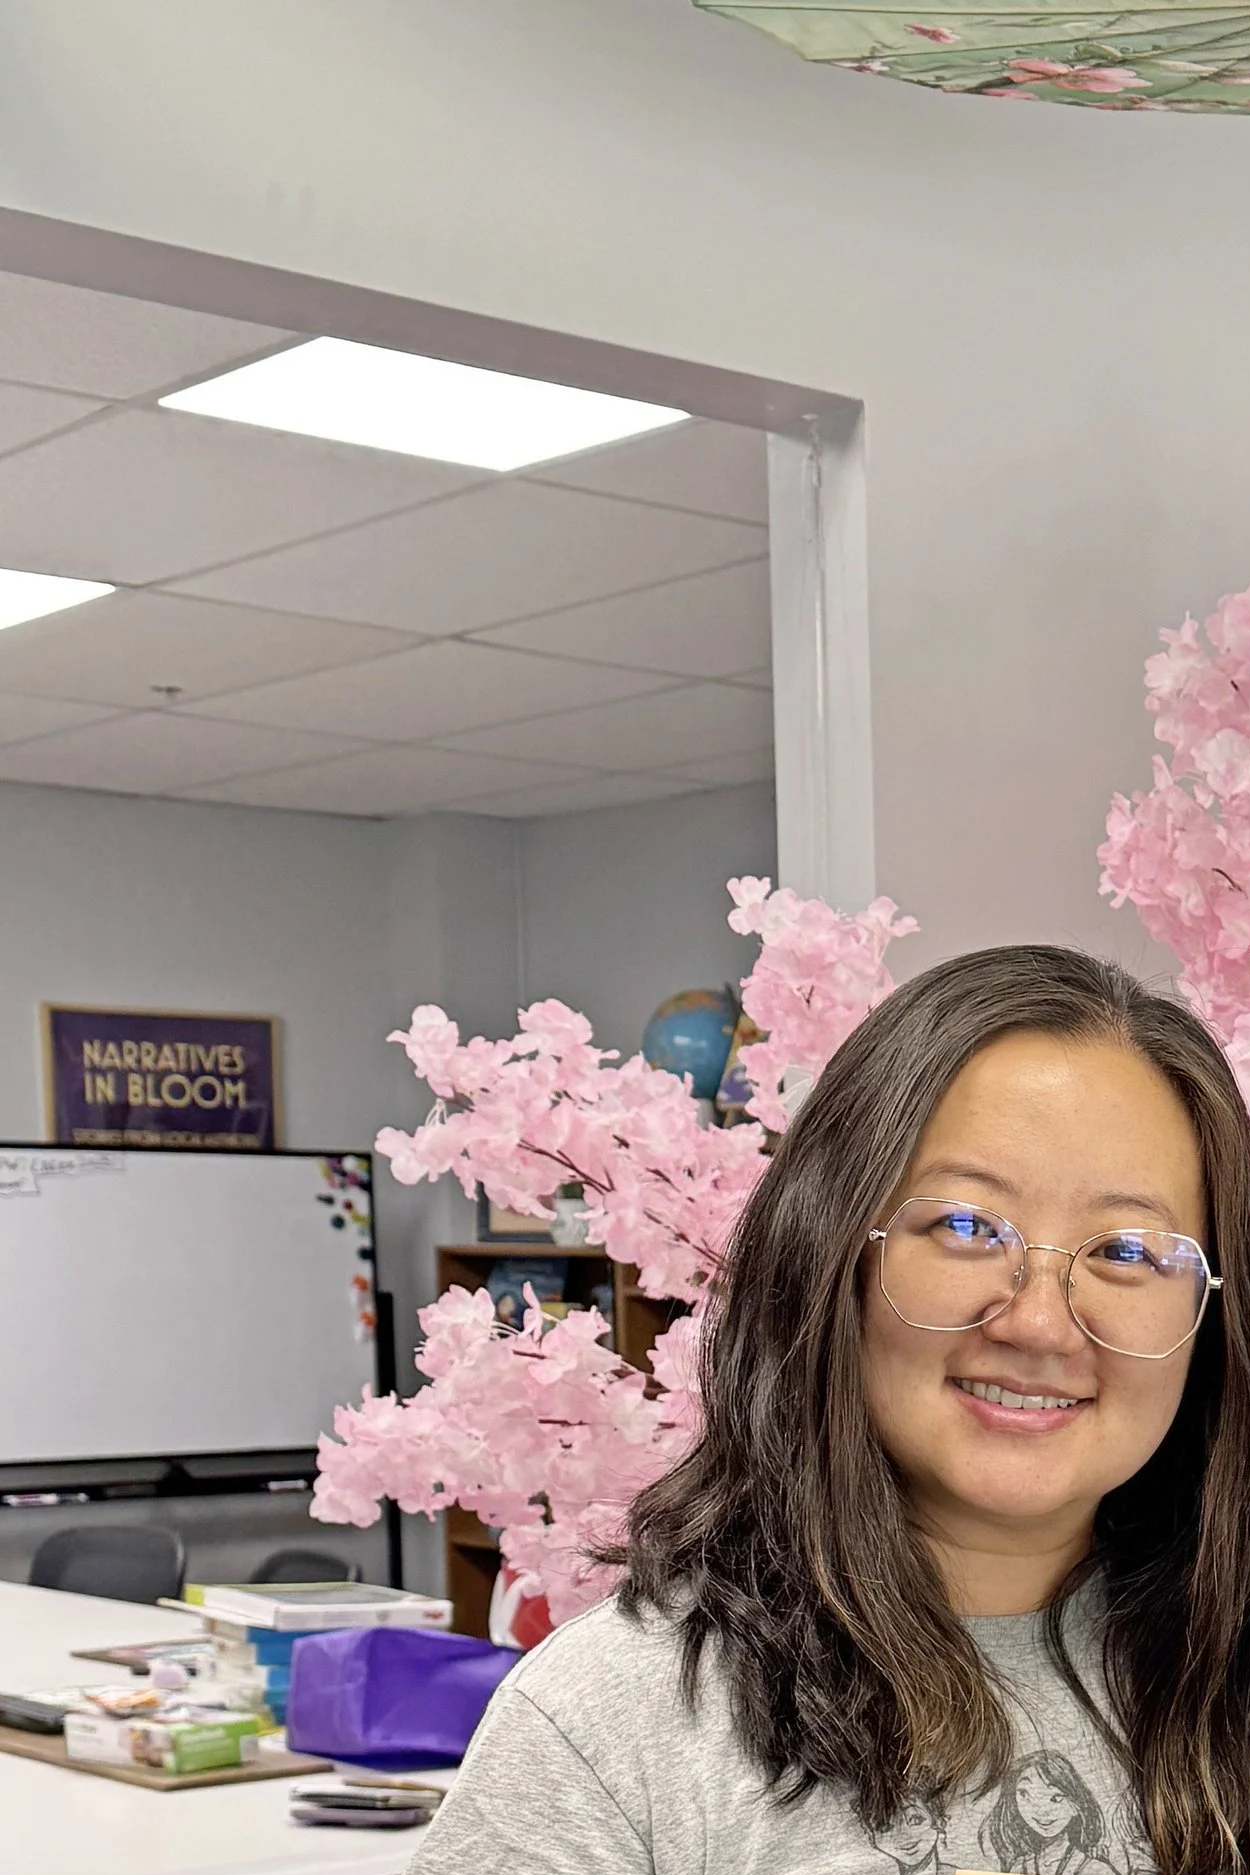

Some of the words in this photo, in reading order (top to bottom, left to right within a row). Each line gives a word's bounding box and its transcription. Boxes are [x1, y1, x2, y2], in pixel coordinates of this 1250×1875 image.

[83, 1039, 247, 1076] NARRATIVES
[84, 1071, 117, 1105] IN
[126, 1073, 248, 1110] BLOOM
